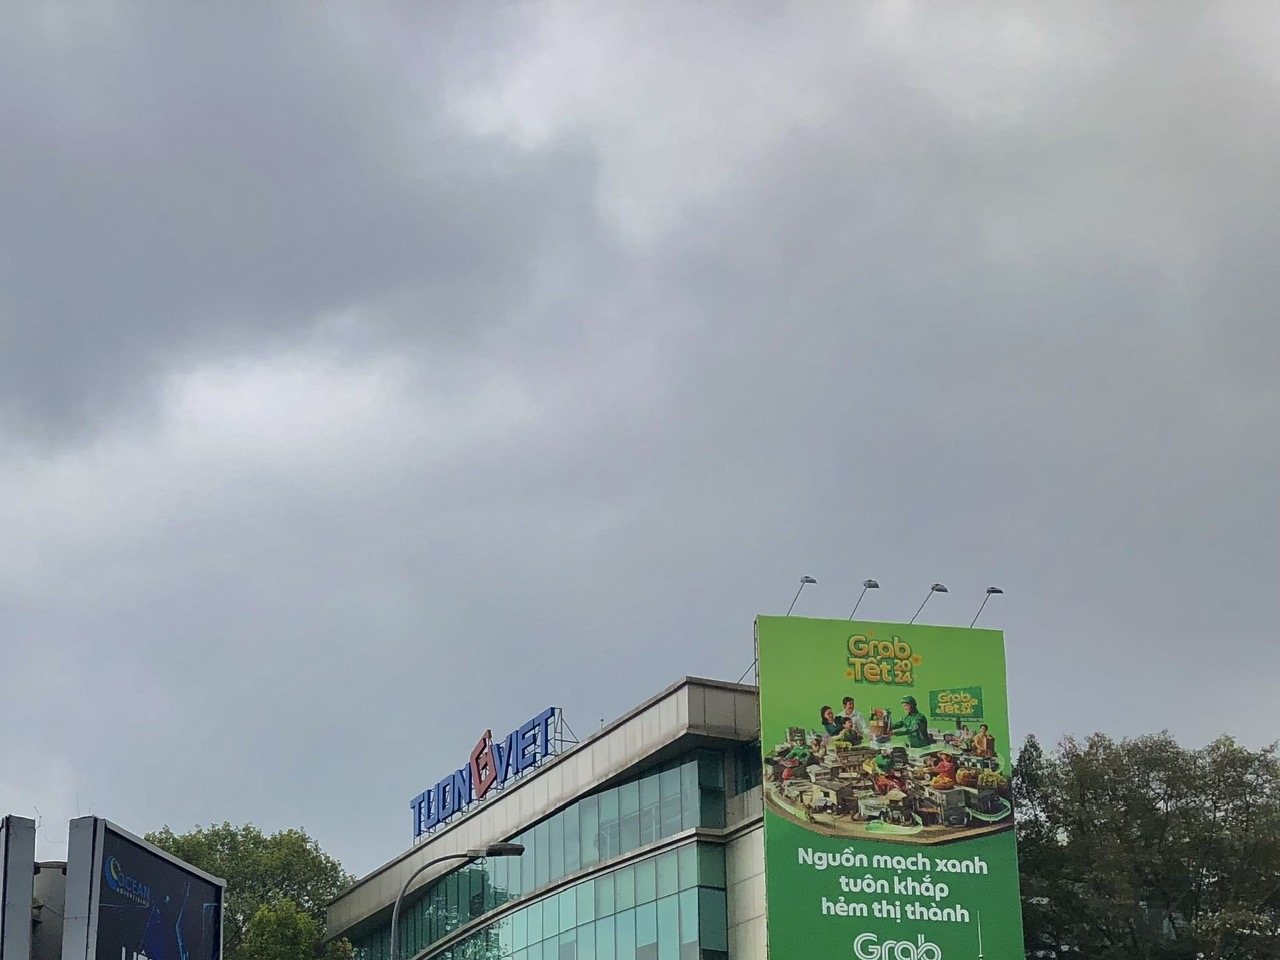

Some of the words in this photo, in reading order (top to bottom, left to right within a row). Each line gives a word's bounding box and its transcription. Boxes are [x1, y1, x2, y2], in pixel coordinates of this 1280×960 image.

[848, 634, 911, 660] Grab
[848, 656, 892, 683] Tết
[938, 691, 971, 703] Grab
[798, 846, 868, 870] Nguồn
[872, 853, 931, 874] mạch
[935, 856, 988, 875] xanh
[117, 873, 151, 900] OCEAN
[839, 873, 890, 894] tuôn
[893, 874, 950, 902] khắp
[821, 896, 868, 917] hẻm
[872, 899, 901, 923] thị
[904, 901, 970, 923] thành
